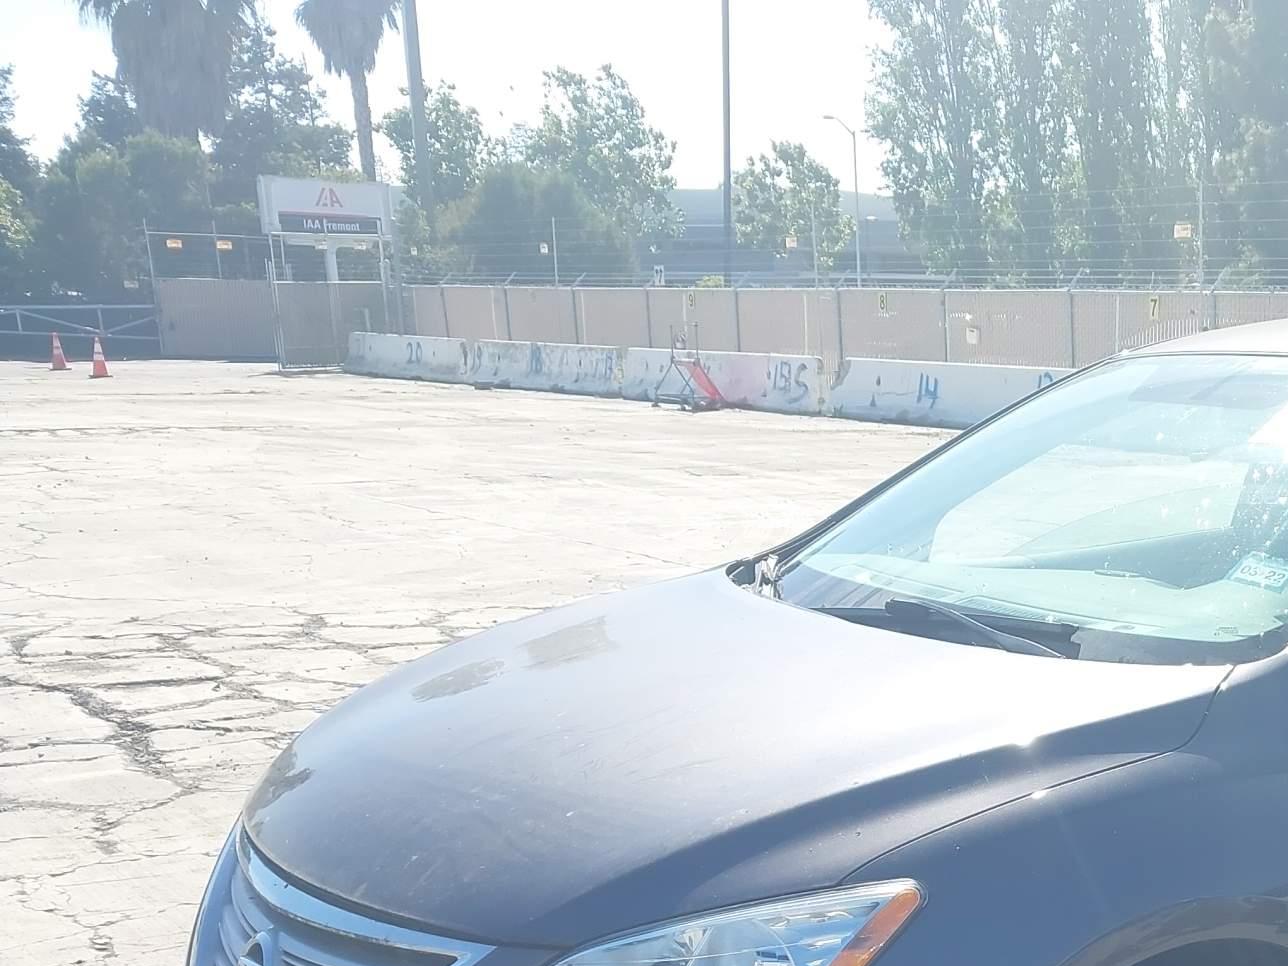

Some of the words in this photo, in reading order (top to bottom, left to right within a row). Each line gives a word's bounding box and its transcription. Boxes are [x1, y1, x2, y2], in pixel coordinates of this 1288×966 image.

[303, 219, 321, 229] IAA
[1150, 298, 1158, 317] 7
[916, 372, 938, 409] 14
